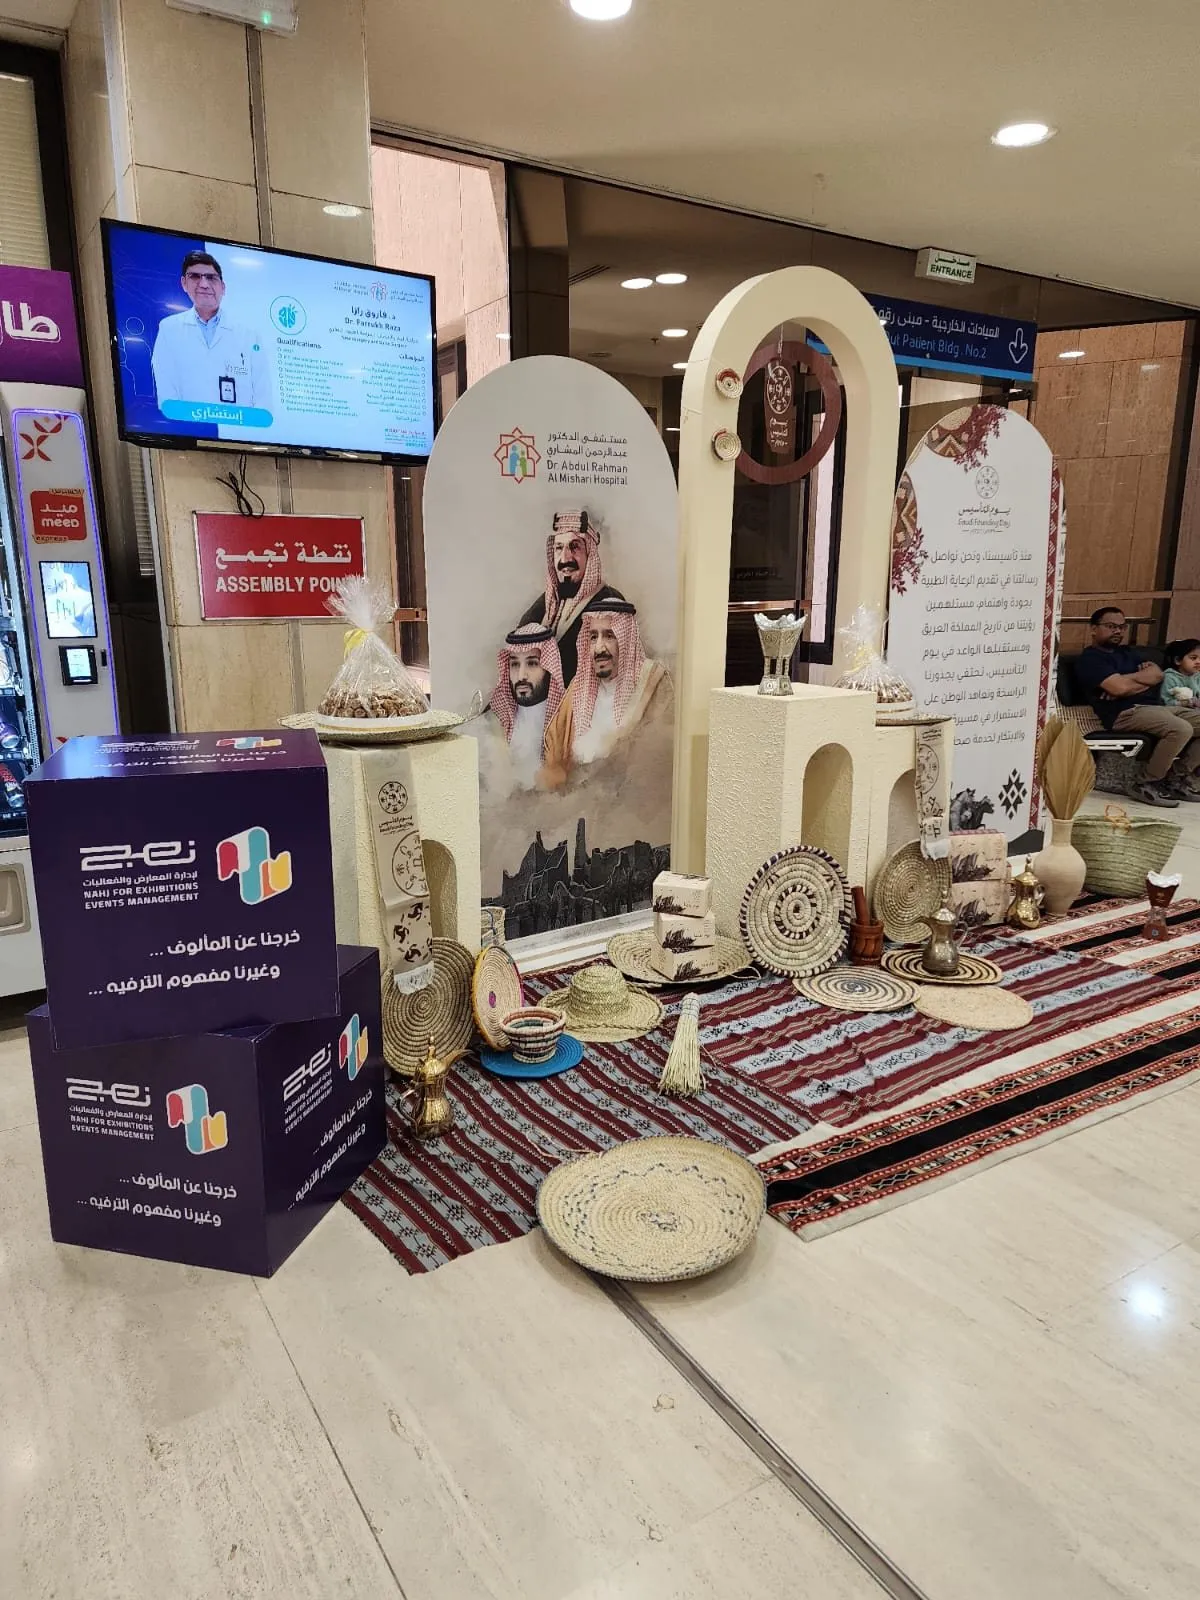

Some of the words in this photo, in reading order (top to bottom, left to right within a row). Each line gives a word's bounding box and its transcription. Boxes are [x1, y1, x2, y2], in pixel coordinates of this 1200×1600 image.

[935, 252, 970, 267] مدخل
[930, 264, 972, 279] ENTRANCE
[897, 311, 922, 328] مبنى
[931, 315, 966, 334] الخارجية
[968, 321, 1000, 339] العيادات
[276, 337, 322, 350] Qualifications
[902, 333, 936, 351] Patient
[965, 343, 987, 359] No.2
[191, 406, 244, 425] إستشاري
[548, 432, 580, 442] الدكتور
[581, 434, 628, 445] مستشفى
[546, 445, 583, 458] المشاري
[585, 447, 628, 458] عبدالرحمن
[561, 461, 589, 472] Abdul
[591, 462, 628, 473] Rahman
[548, 473, 557, 483] Al
[559, 474, 592, 484] Mishari
[594, 475, 628, 487] Hospital
[40, 503, 78, 517] ميد
[215, 542, 289, 570] تجمع
[294, 541, 352, 563] نقطة
[931, 551, 958, 564] نواصل
[960, 554, 981, 564] ونحن
[1018, 553, 1032, 562] منذ
[215, 575, 305, 593] ASSEMBLY
[309, 575, 347, 593] POIN
[921, 575, 948, 588] الطبية
[951, 575, 975, 588] الرعاية
[976, 576, 999, 588] تقديم
[1001, 578, 1011, 590] في
[1012, 574, 1039, 586] رسالتنا
[926, 598, 974, 612] مستلهمين
[1010, 599, 1032, 610] بجودة
[921, 623, 949, 636] العريق
[951, 621, 982, 632] المملكة
[983, 621, 1002, 635] تاريخ
[1004, 622, 1015, 633] من
[1016, 619, 1036, 632] رؤيتنا
[922, 648, 940, 661] يوم
[941, 649, 955, 660] في
[956, 645, 982, 657] الواعد
[984, 643, 1031, 655] ومستقبلها
[924, 669, 956, 683] بجذورنا
[957, 667, 985, 681] نحتفي
[924, 692, 940, 705] على
[942, 691, 966, 705] الوطن
[968, 689, 995, 701] ونعاهد
[996, 686, 1027, 698] الراسخة
[980, 712, 991, 726] في
[992, 708, 1027, 721] الاستمرار
[972, 732, 996, 744] لخدمة
[82, 876, 132, 888] والفعاليات
[133, 872, 172, 885] المعارض
[174, 870, 198, 881] لإدارة
[83, 889, 110, 899] NAHJ
[112, 887, 133, 897] FOR
[135, 882, 199, 895] EXHIBITIONS
[85, 898, 125, 910] EVENTS
[127, 892, 199, 906] MANAGEMENT
[167, 935, 231, 956] المألوف
[234, 934, 257, 951] عن
[260, 929, 300, 948] خرجنا
[234, 963, 280, 980] وغيرنا
[106, 973, 163, 995] الترفيه
[166, 969, 231, 990] مفهوم
[356, 1088, 373, 1112] خرجنا
[69, 1105, 104, 1117] والفعاليات
[105, 1110, 134, 1119] المعارض
[347, 1107, 356, 1122] عن
[90, 1117, 105, 1126] FOR
[106, 1119, 154, 1131] EXHIBITIONS
[320, 1112, 347, 1147] المألوف
[71, 1124, 100, 1134] EVENTS
[101, 1127, 155, 1141] MANAGEMENT
[347, 1122, 366, 1147] وغيرنا
[320, 1142, 347, 1179] مفهوم
[132, 1173, 181, 1191] المألوف
[184, 1179, 202, 1196] عن
[295, 1167, 320, 1202] الترفيه
[203, 1182, 237, 1200] خرجنا
[89, 1195, 130, 1213] الترفيه
[132, 1203, 182, 1219] مفهوم
[184, 1208, 222, 1228] وغيرنا
